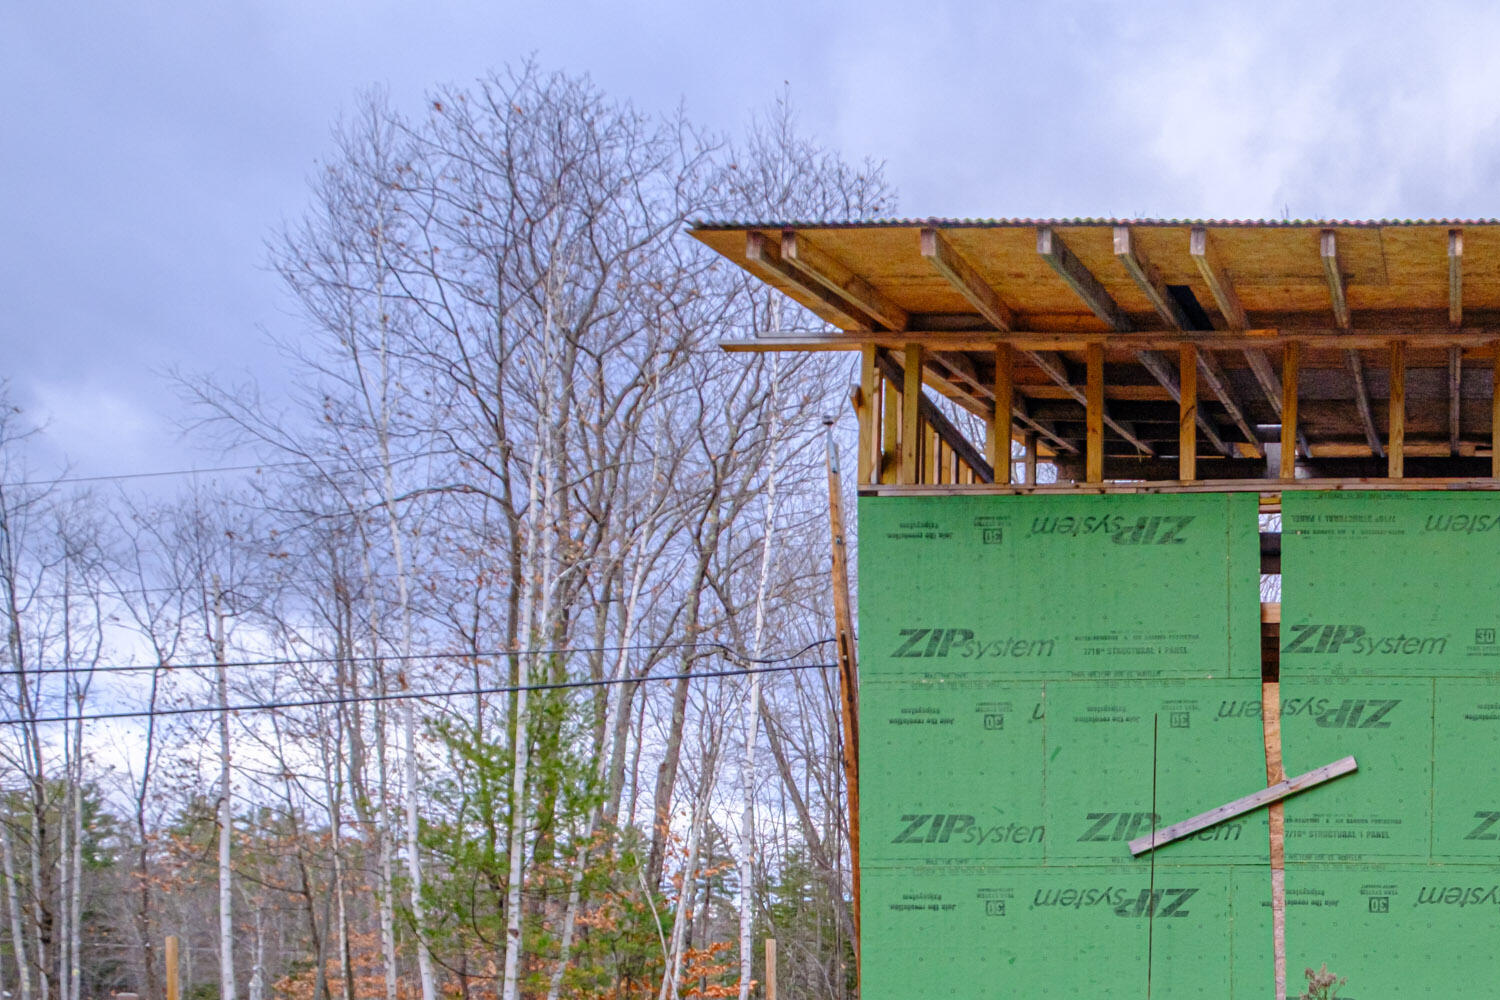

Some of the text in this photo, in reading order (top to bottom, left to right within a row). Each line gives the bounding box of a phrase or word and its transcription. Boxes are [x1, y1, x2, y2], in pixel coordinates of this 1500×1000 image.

[1291, 515, 1315, 523] PANEL
[1030, 513, 1196, 545] ZIPsystem
[985, 530, 1001, 543] 30
[1281, 624, 1447, 656] ZIPsystem
[1477, 630, 1494, 643] 30
[890, 628, 1055, 660] ZIPsystem
[1164, 646, 1187, 654] PANEL
[985, 716, 1002, 729] 30
[1172, 714, 1188, 727] 30
[1076, 813, 1243, 842] ZIPem
[1366, 830, 1391, 839] PANEL
[1033, 886, 1198, 917] ZIPsystem
[1371, 898, 1387, 911] 30
[987, 902, 1004, 915] 30
